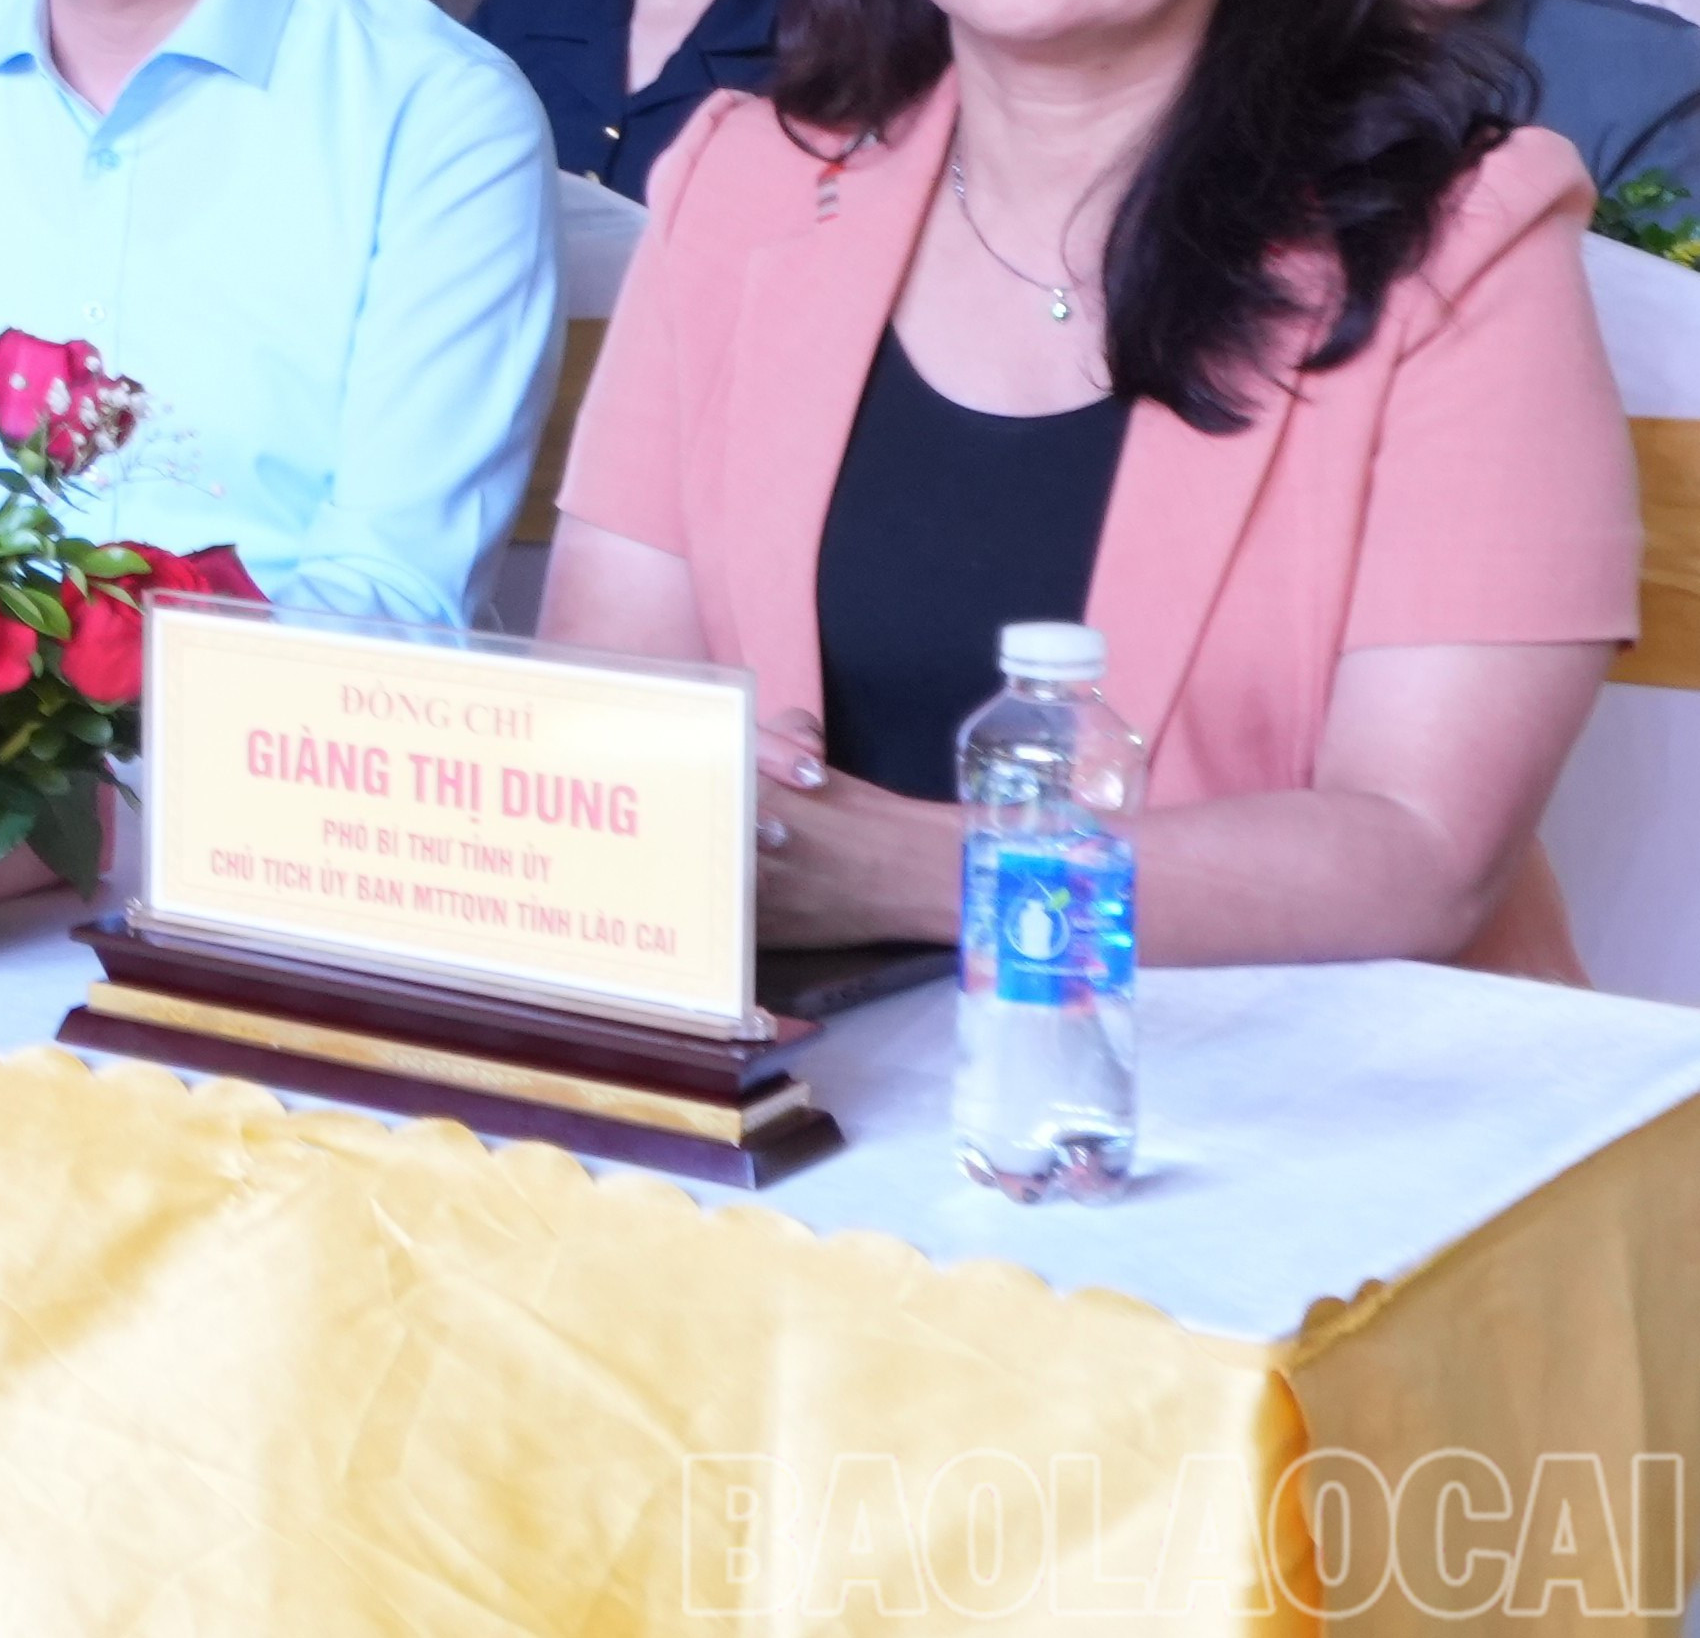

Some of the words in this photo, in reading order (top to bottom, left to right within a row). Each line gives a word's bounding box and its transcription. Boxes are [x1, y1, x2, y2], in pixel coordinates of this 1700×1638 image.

[341, 682, 451, 730] ĐỒNG
[246, 725, 392, 797] GIÀNG
[408, 753, 483, 824] THỊ
[501, 767, 641, 838] DUNG
[322, 816, 369, 852] PHÓ
[408, 832, 453, 867] THƯ
[458, 834, 514, 876] TỈNH
[522, 845, 552, 883] ỦY
[210, 844, 255, 882] CHỦ
[262, 855, 313, 895] TỊCH
[319, 862, 350, 899] ỦY
[356, 873, 404, 909] BAN
[413, 883, 509, 928] MTTQVN
[517, 894, 572, 939] TỈNH
[580, 909, 627, 948] LÀO
[635, 922, 678, 957] CAI
